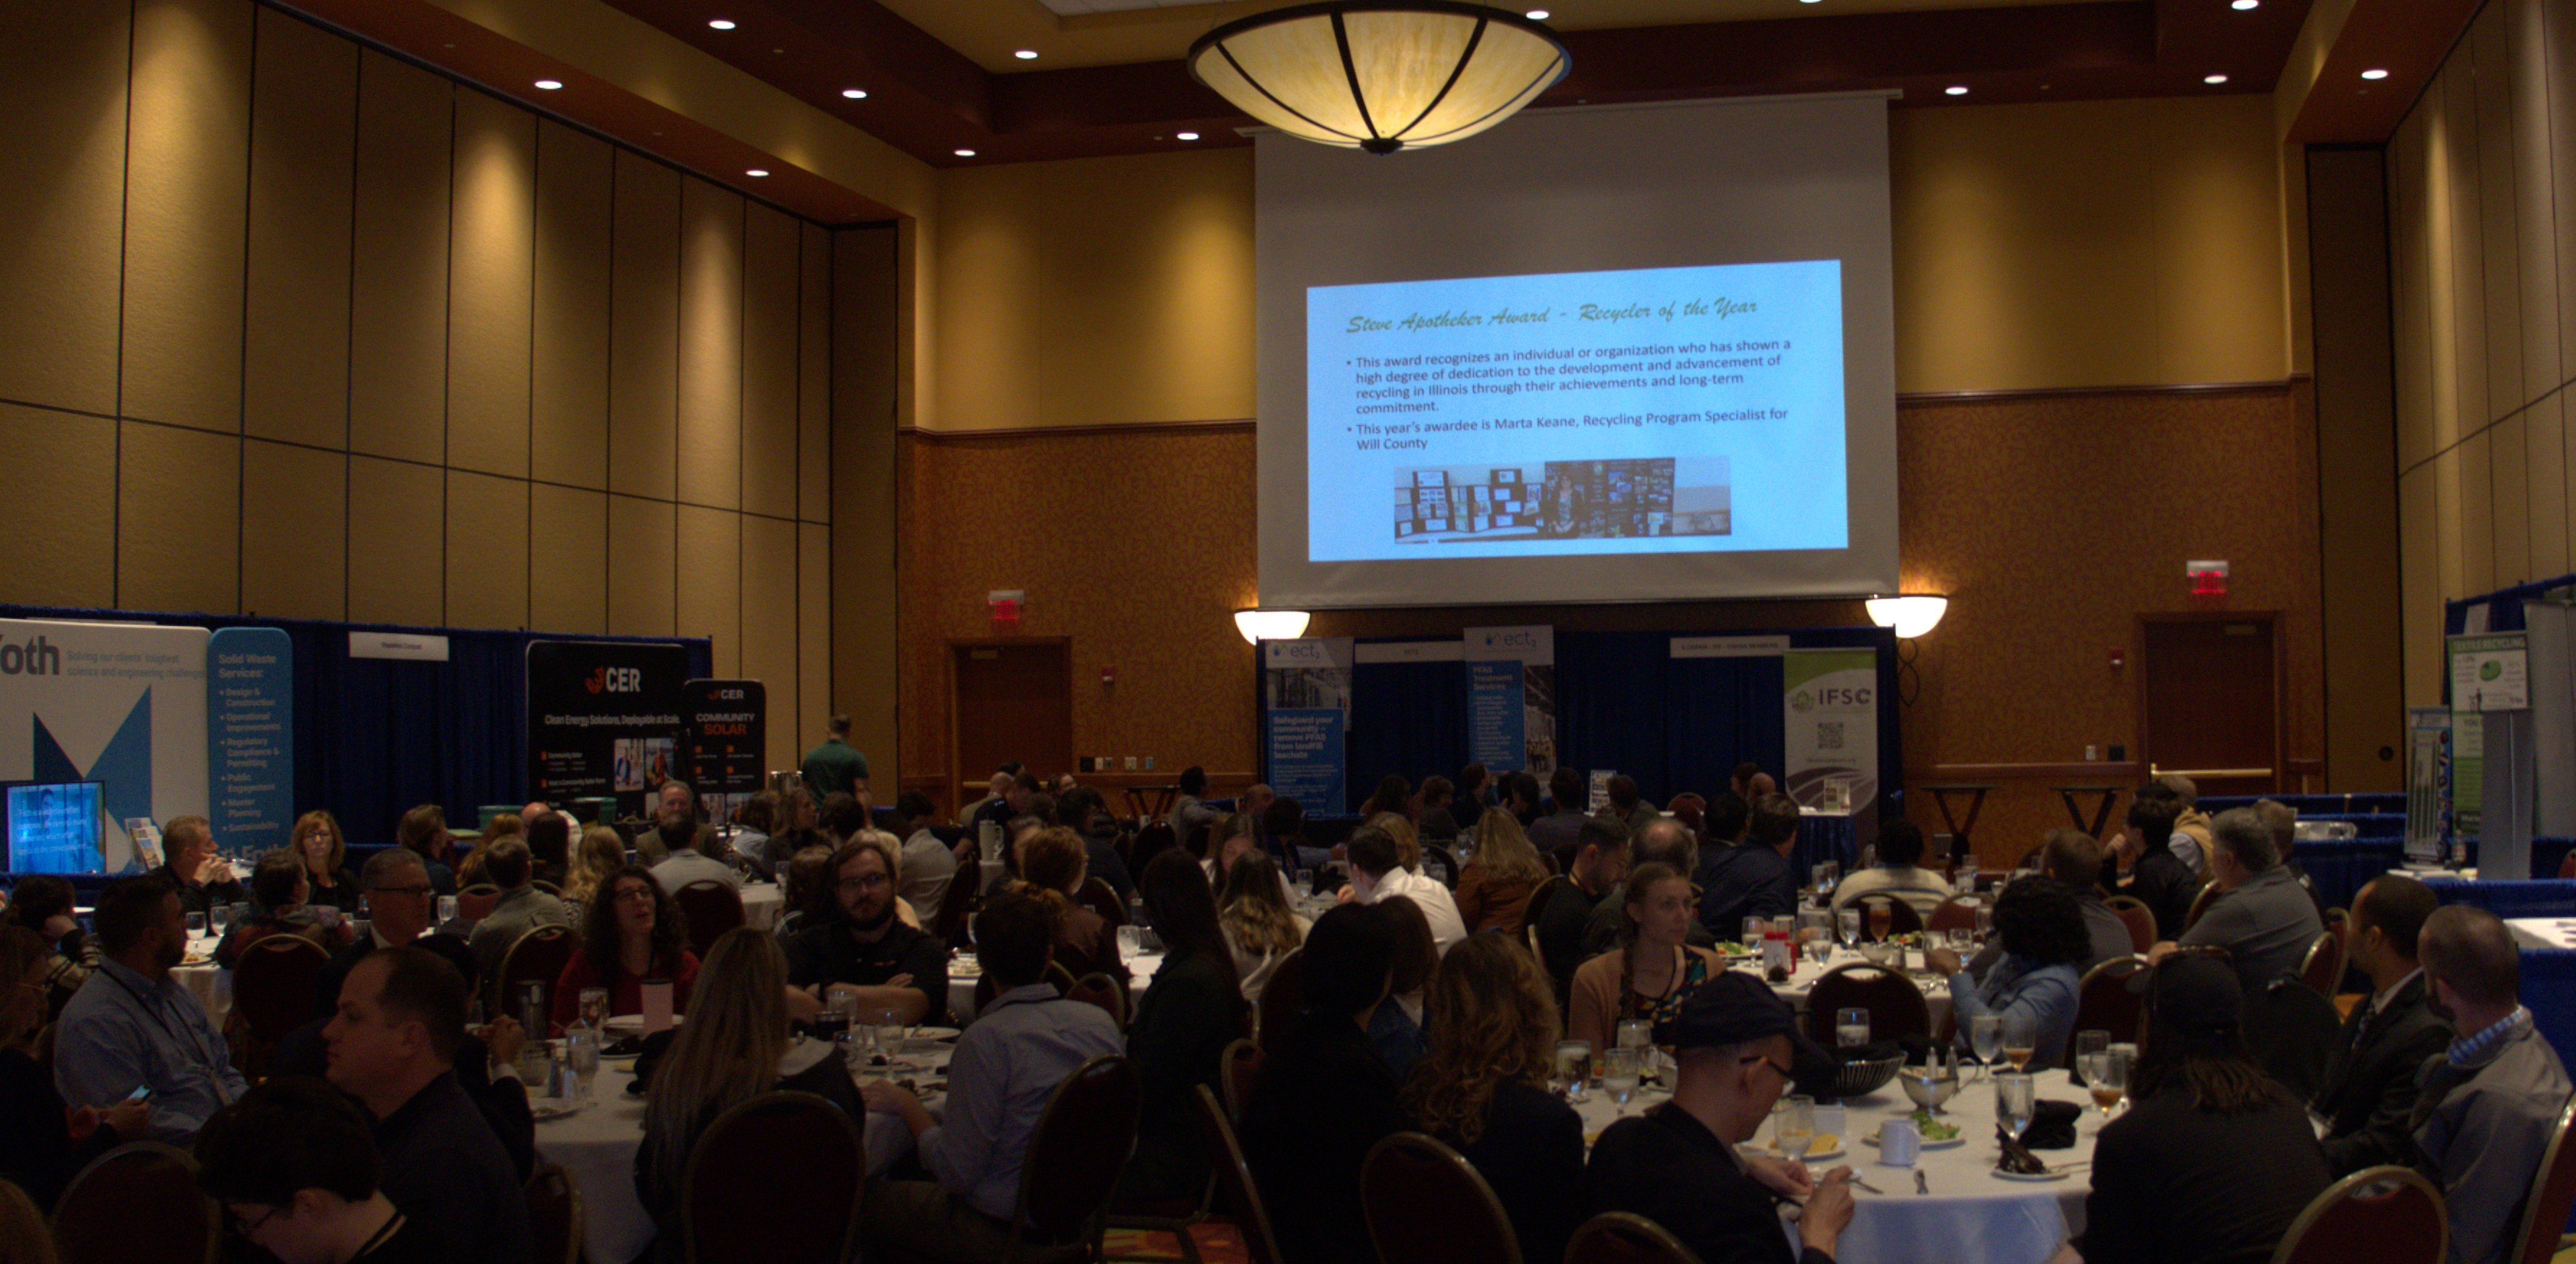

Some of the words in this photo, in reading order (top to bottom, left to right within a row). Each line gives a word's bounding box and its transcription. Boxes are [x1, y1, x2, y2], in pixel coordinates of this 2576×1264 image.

[1346, 315, 1392, 333] Steve
[1397, 309, 1483, 333] Apotheker
[1487, 307, 1551, 326] Award
[1579, 303, 1651, 323] Recycler
[1658, 300, 1676, 322] of
[1683, 297, 1708, 316] the
[1713, 296, 1757, 320] Year
[1356, 357, 1381, 368] This
[1384, 354, 1422, 367] award
[1426, 352, 1490, 366] recognizes
[1494, 352, 1509, 361] an
[1513, 347, 1575, 361] individual
[1578, 349, 1591, 358] or
[1595, 344, 1674, 359] organization
[1678, 341, 1706, 354] who
[1710, 340, 1732, 352] has
[1736, 339, 1779, 351] shown
[1783, 341, 1791, 349] a
[1356, 372, 1382, 385] high
[1386, 372, 1428, 384] degree
[1431, 369, 1445, 380] of
[1448, 367, 1513, 380] dedication
[1517, 366, 1531, 377] to
[1534, 364, 1555, 375] the
[1559, 361, 1643, 375] development
[1647, 359, 1671, 371] and
[1675, 357, 1764, 370] advancement
[1767, 354, 1781, 366] of
[1356, 386, 1410, 400] recycling
[1413, 385, 1425, 396] in
[1428, 384, 1468, 396] Illinois
[1472, 382, 1521, 395] through
[1526, 380, 1555, 392] their
[1559, 377, 1647, 391] achievements
[1651, 375, 1675, 387] and
[1679, 372, 1744, 387] long-term
[1356, 401, 1439, 414] commitment.
[1356, 423, 1381, 435] This
[1384, 421, 1421, 436] year's
[1424, 419, 1478, 432] awardee
[1481, 418, 1491, 430] is
[1495, 418, 1533, 429] Marta
[1536, 416, 1580, 429] Keane,
[1582, 412, 1642, 428] Recycling
[1647, 411, 1701, 426] Program
[1705, 408, 1765, 423] Specialist
[1769, 407, 1789, 420] for
[1356, 439, 1380, 450] Will
[1383, 437, 1428, 452] County
[0, 634, 60, 676] oth
[218, 653, 245, 664] Solid
[246, 653, 277, 664] Waste
[605, 666, 642, 693] CER
[720, 689, 745, 700] CER
[1819, 688, 1871, 706] IFSC
[544, 714, 564, 725] Clean
[564, 714, 590, 727] Energy
[695, 712, 756, 722] COMMUNITY
[703, 722, 747, 736] SOLAR
